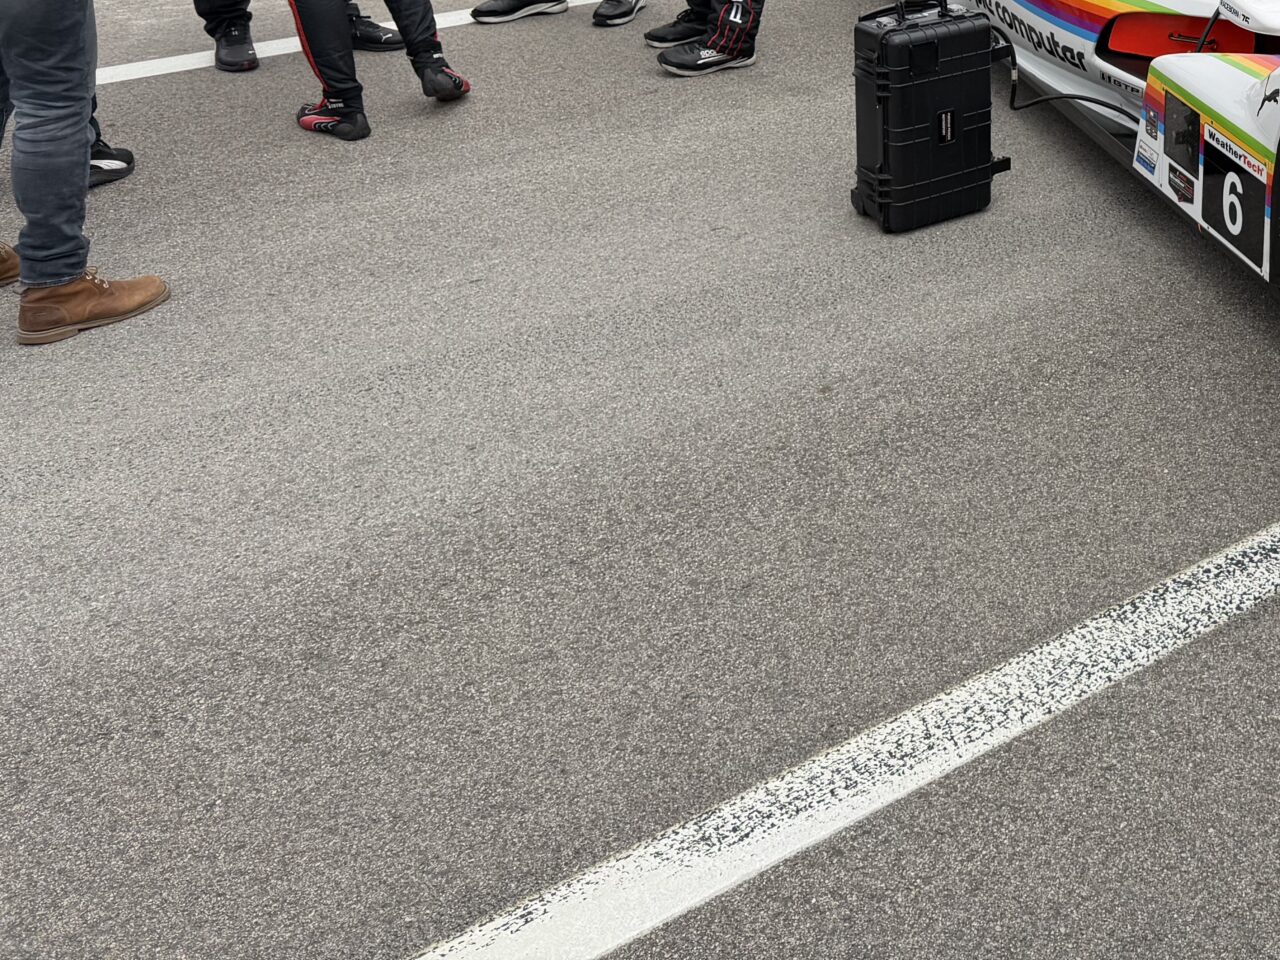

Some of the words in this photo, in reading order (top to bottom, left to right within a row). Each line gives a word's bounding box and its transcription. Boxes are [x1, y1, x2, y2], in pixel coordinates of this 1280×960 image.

[995, 1, 1088, 72] computer
[1207, 128, 1265, 176] WeatherTech
[1222, 171, 1244, 236] 6
